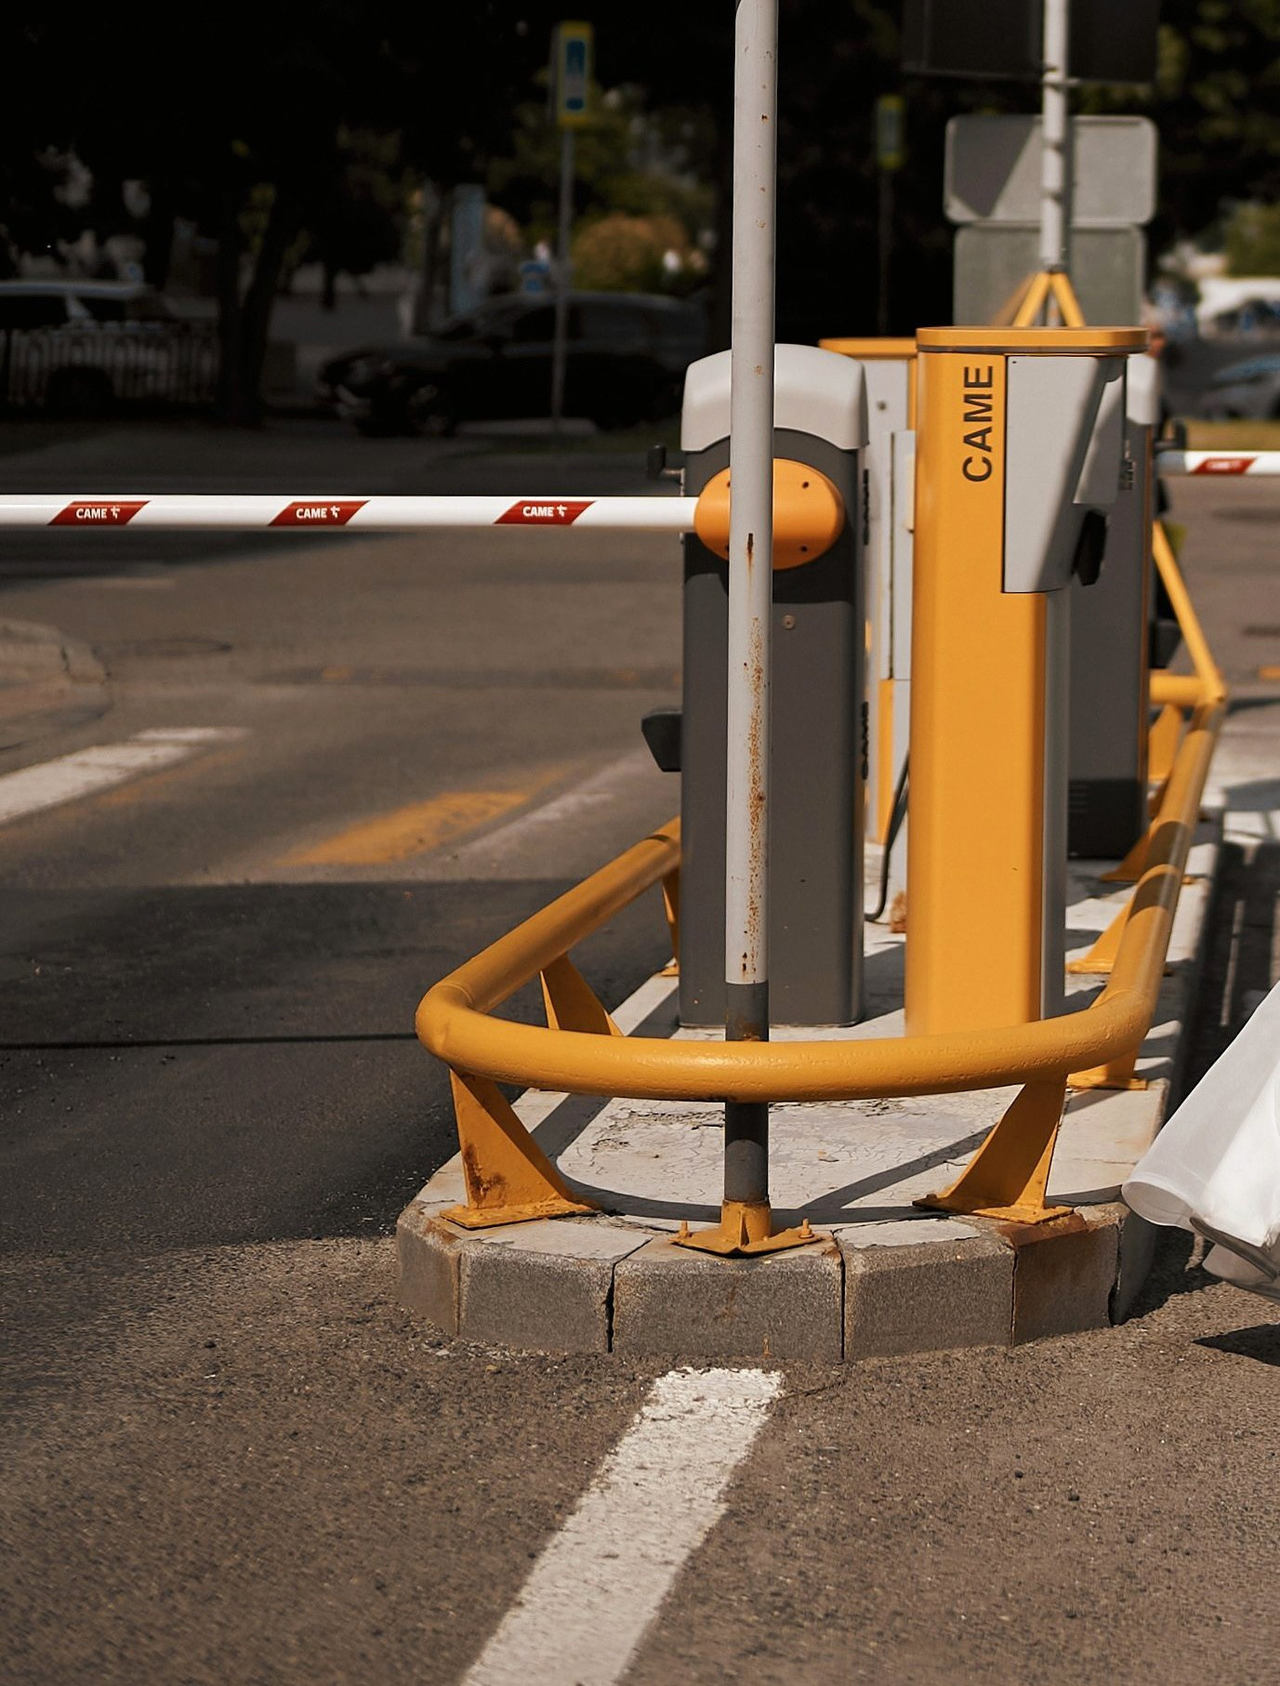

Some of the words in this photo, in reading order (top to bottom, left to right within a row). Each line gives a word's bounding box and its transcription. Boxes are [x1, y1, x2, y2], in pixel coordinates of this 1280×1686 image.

[962, 365, 994, 483] CAME
[75, 507, 108, 520] CAME
[296, 507, 328, 519] CAME
[522, 505, 555, 517] CAME
